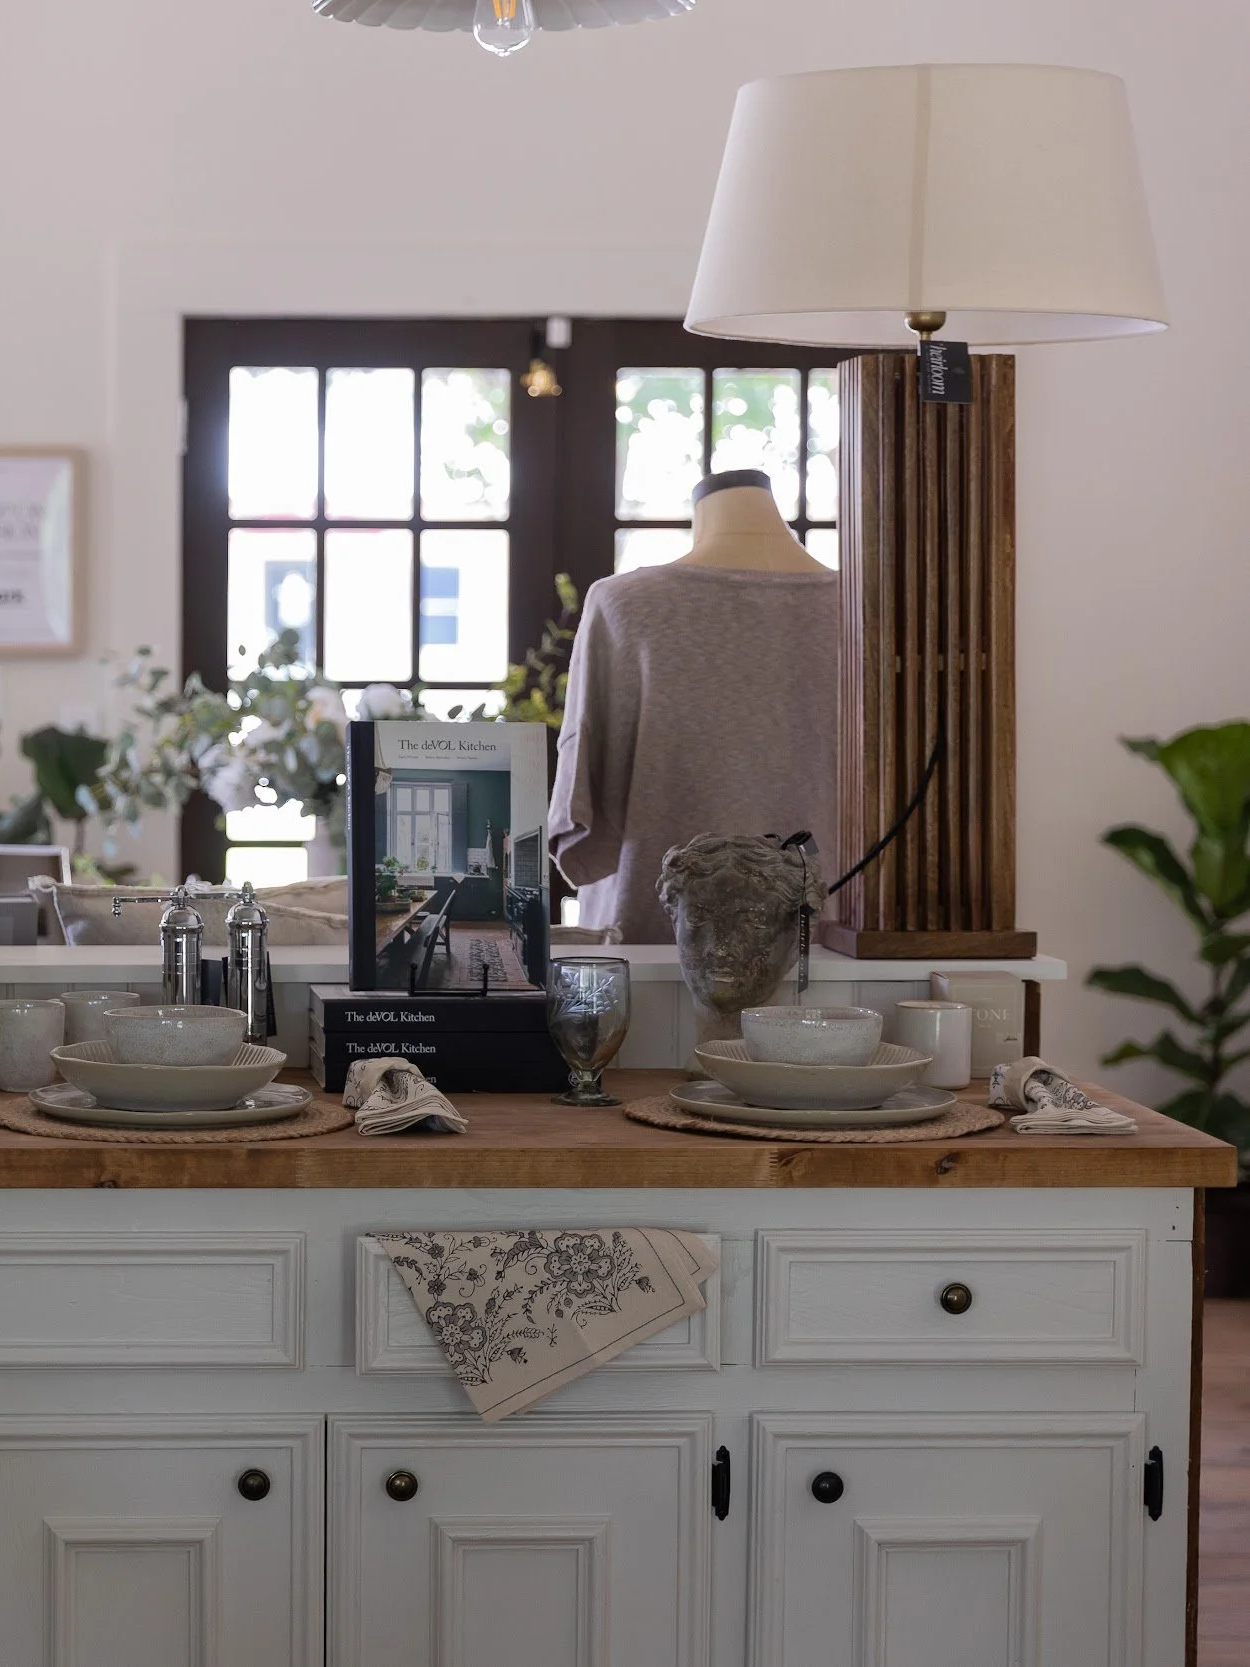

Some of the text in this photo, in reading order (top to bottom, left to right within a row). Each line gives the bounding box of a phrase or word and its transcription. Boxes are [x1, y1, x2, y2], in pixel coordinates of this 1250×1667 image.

[398, 740, 497, 751] The deVOL Kitchen
[344, 1011, 435, 1022] The deVOL Kitchen
[345, 1043, 436, 1053] The deVOL Kitchen
